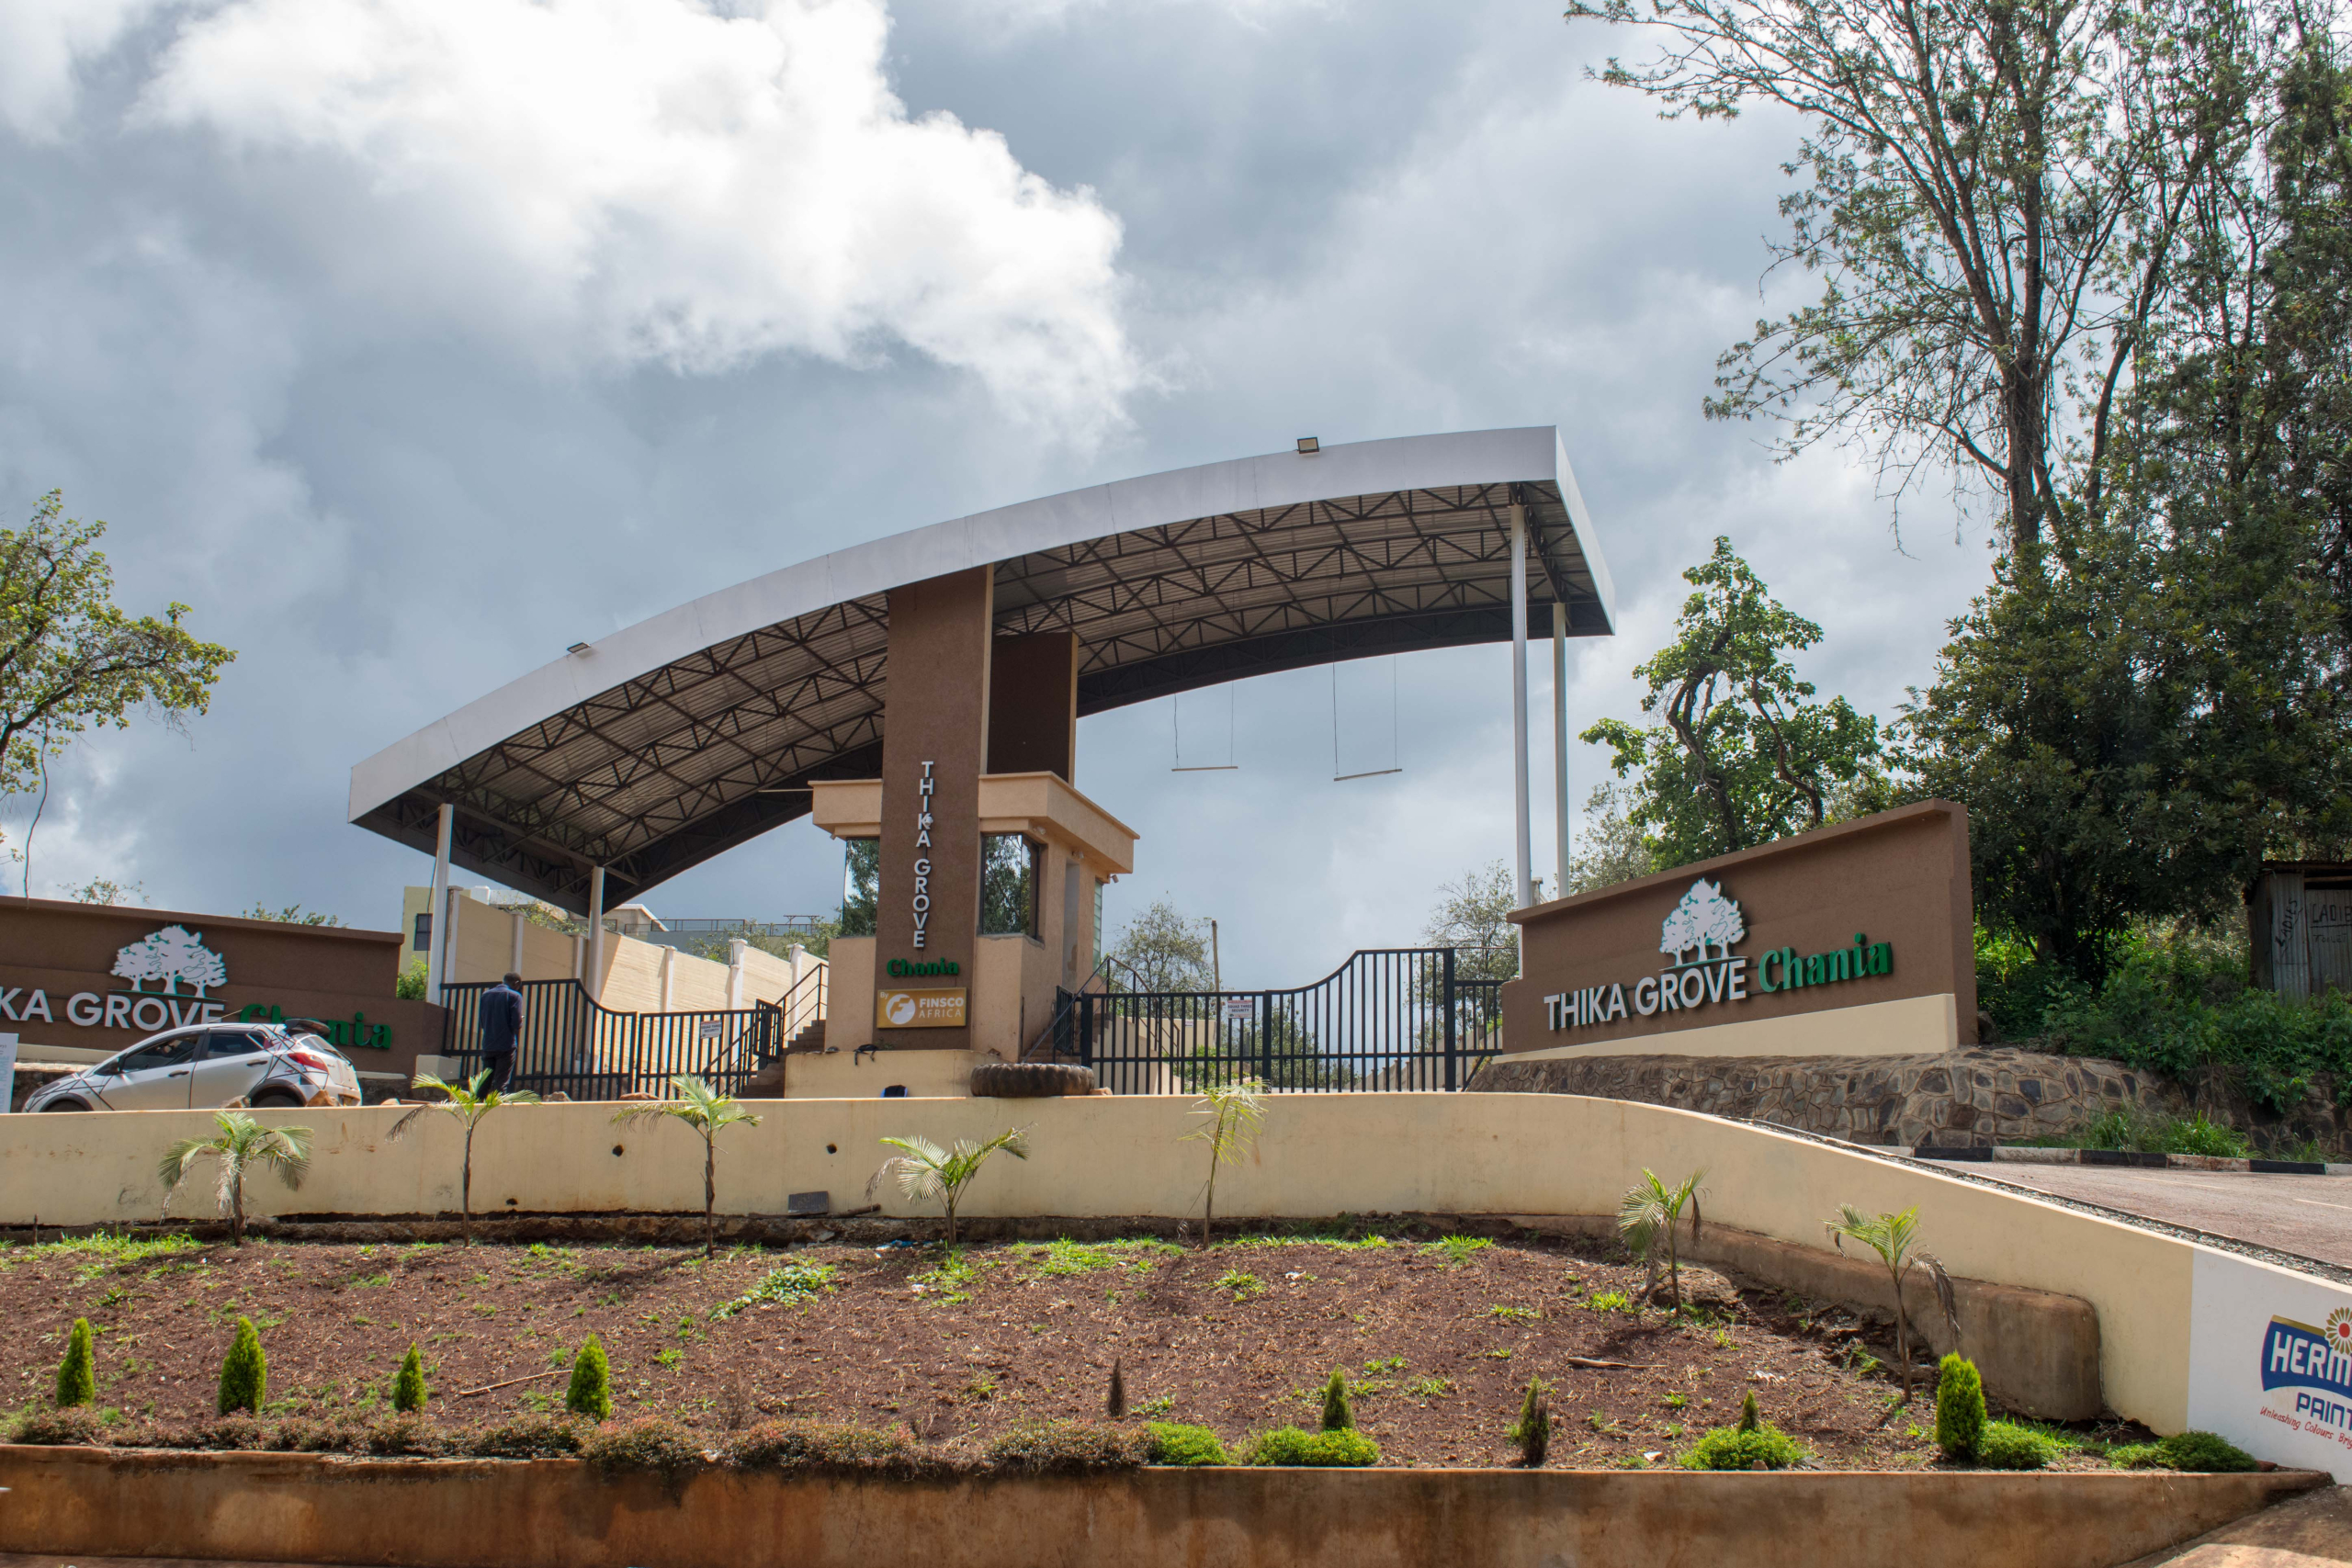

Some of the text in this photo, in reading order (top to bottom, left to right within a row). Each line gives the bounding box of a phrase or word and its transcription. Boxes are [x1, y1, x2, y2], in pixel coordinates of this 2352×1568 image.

[912, 761, 934, 947] THIKA GROVE
[2275, 897, 2298, 947] LADIES
[887, 957, 959, 976] Chania
[1544, 932, 1893, 1031] THIKA GROVE Chania
[879, 992, 889, 1000] By
[920, 997, 965, 1008] FINSCO
[66, 992, 225, 1032] GROVE
[240, 1003, 392, 1049] Cnia
[919, 1009, 962, 1018] AFRICA
[2260, 1405, 2301, 1430] Unleashing
[2304, 1421, 2335, 1439] Colours
